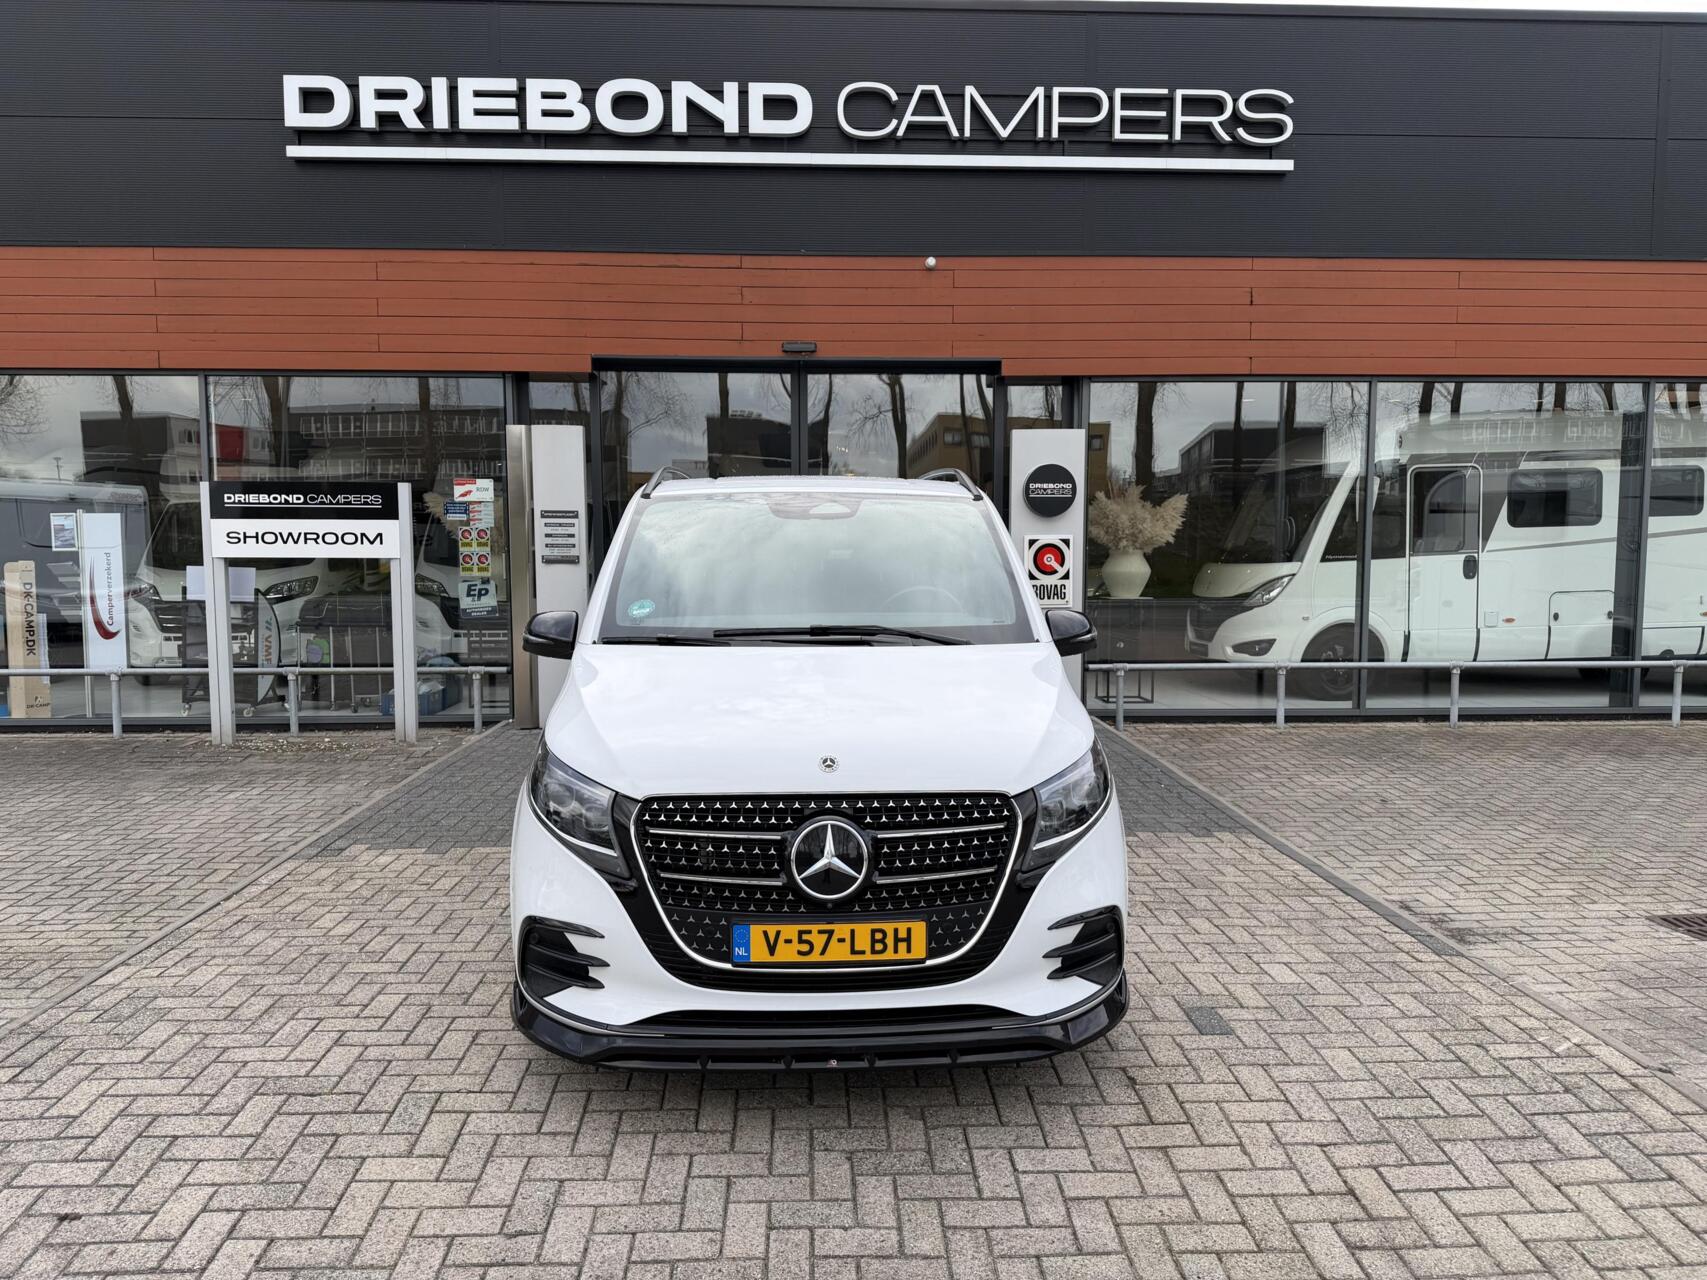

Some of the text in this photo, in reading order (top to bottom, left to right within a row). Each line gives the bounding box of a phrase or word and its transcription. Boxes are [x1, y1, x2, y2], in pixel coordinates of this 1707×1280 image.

[282, 74, 1295, 146] DRIEBOND CAMPERS
[224, 493, 382, 505] DRIEBOND CAMPERS
[226, 531, 384, 546] SHOWROOM
[104, 552, 114, 626] Camperverzekerd
[22, 582, 37, 656] DK-CAMP.DK
[735, 947, 748, 956] NL
[762, 926, 913, 957] V-57-LBH
